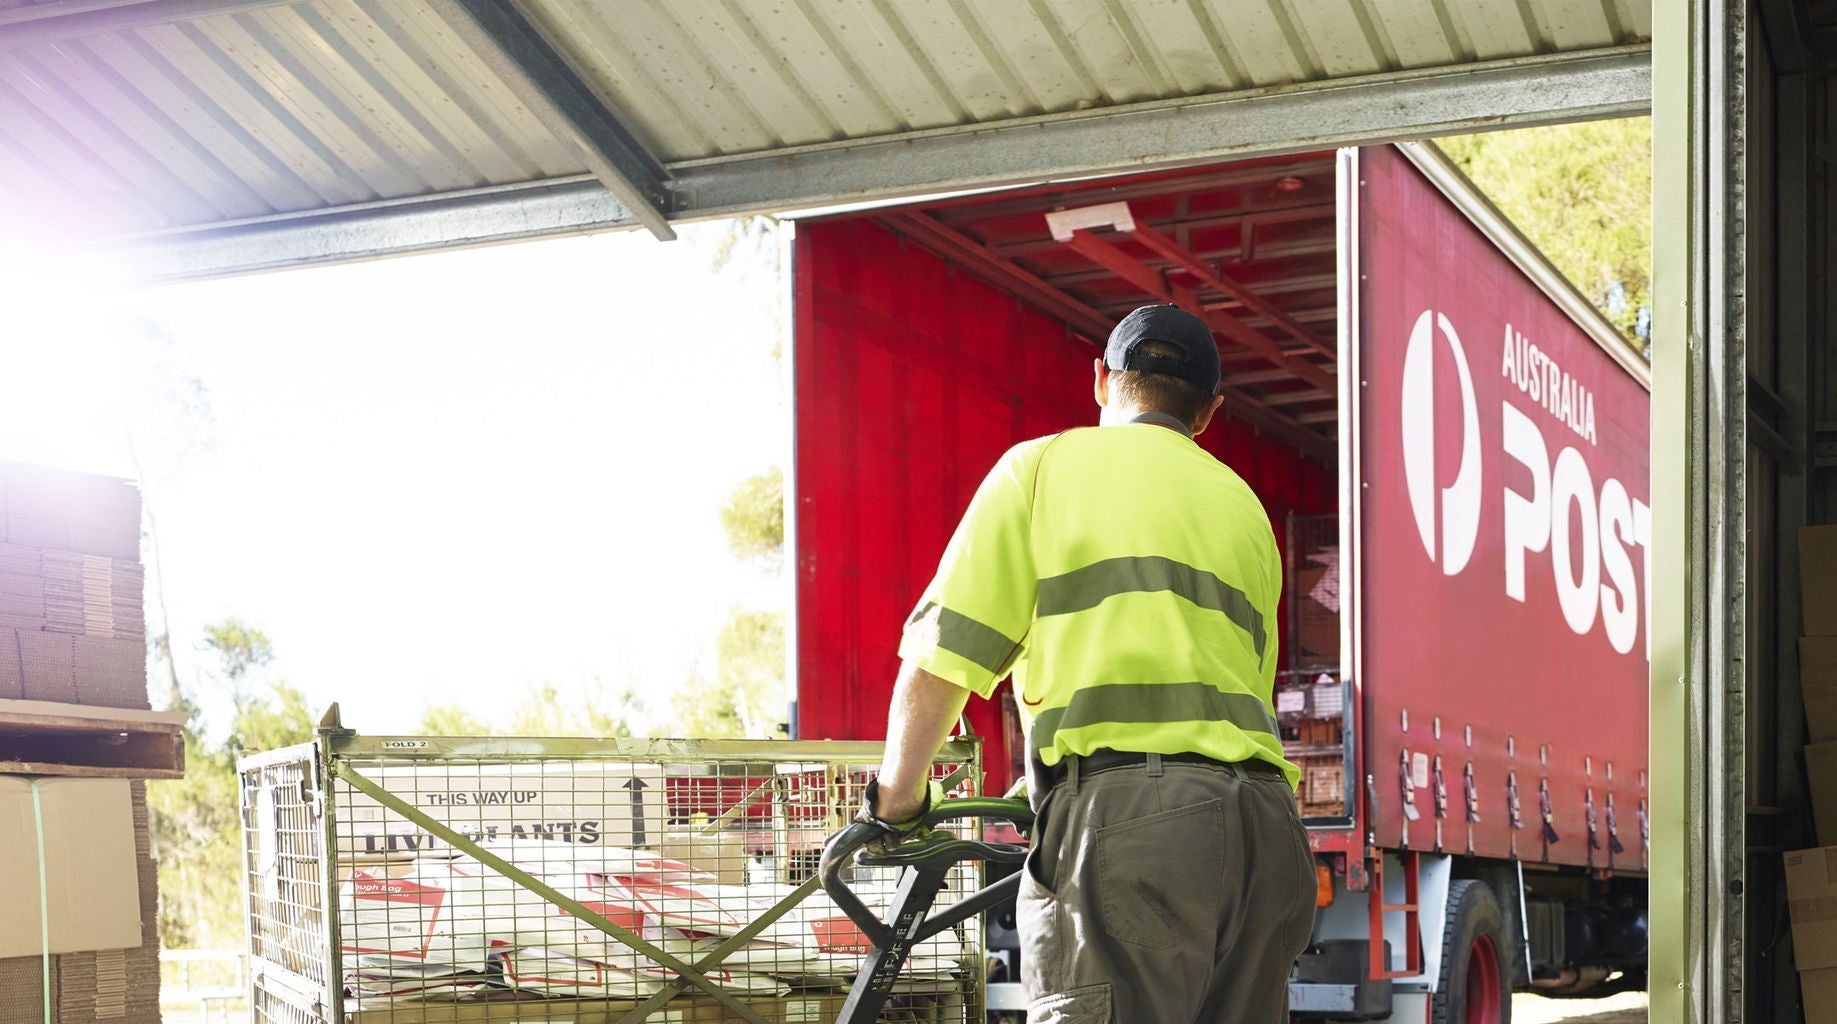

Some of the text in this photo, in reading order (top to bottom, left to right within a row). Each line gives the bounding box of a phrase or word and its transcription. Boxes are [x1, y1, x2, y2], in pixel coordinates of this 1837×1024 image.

[1502, 323, 1597, 446] AUSTRALIA
[426, 791, 538, 805] THIS WAY UP
[355, 884, 379, 892] ough
